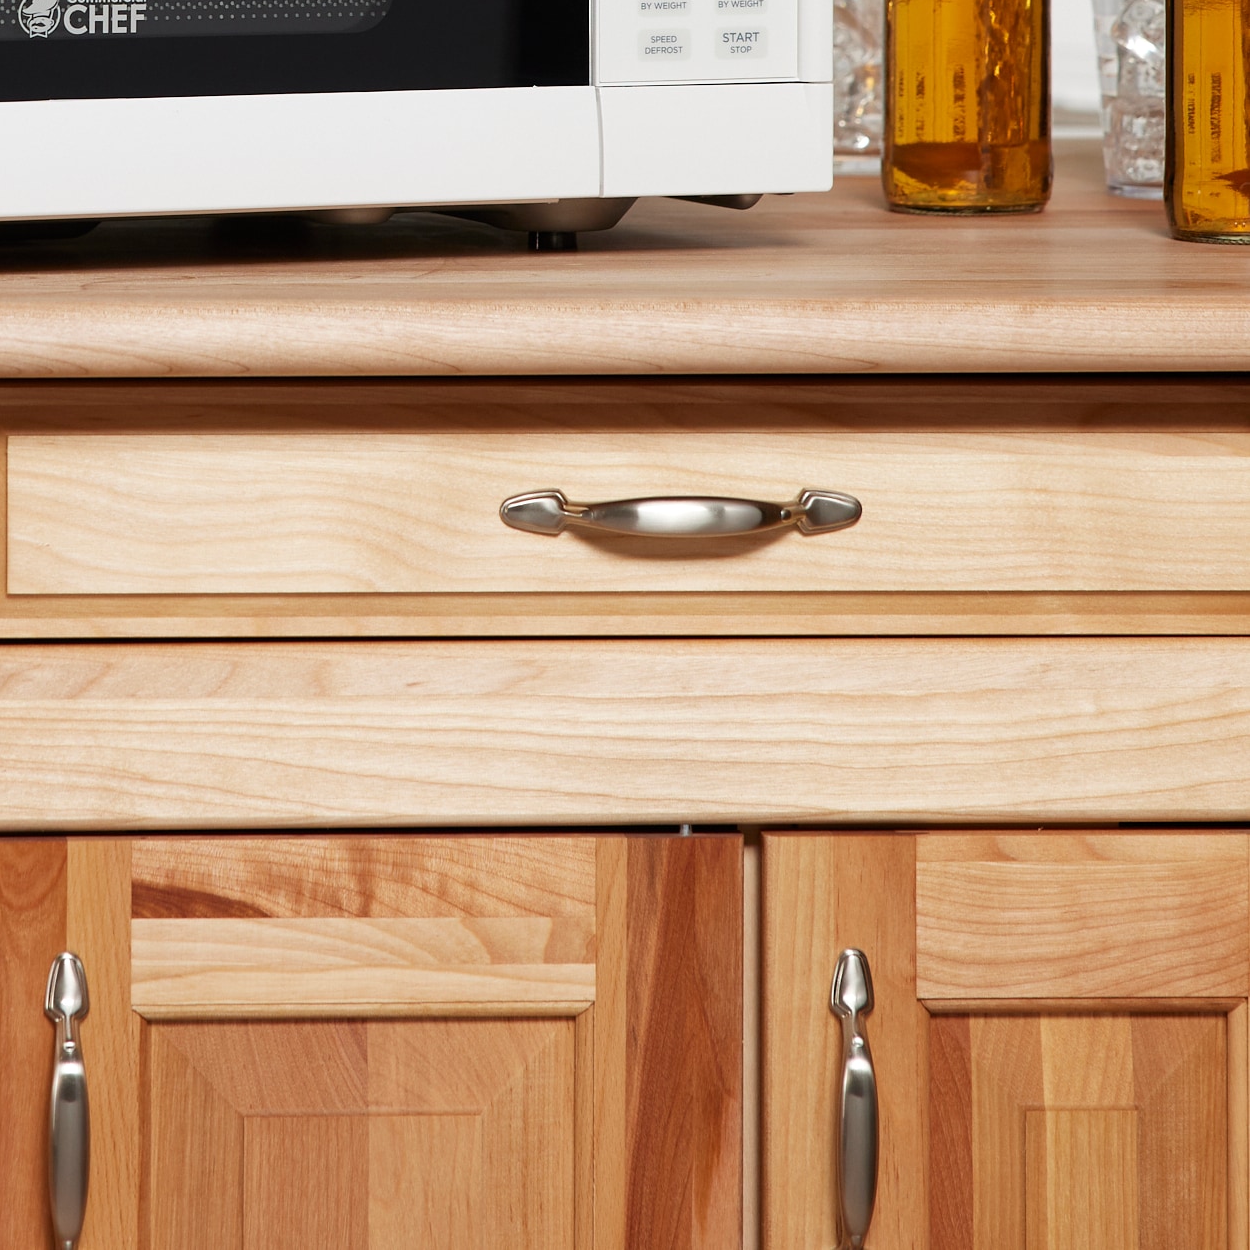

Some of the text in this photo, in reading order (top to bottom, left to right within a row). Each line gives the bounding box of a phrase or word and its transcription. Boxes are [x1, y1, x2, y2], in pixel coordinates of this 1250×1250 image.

[641, 2, 687, 11] BY WEIGHT
[718, 0, 765, 9] BY WEIGHT
[64, 4, 146, 34] CHEF
[651, 36, 678, 44] SPEED
[723, 32, 759, 42] START
[645, 46, 683, 55] DEFROST
[731, 46, 753, 54] STOP
